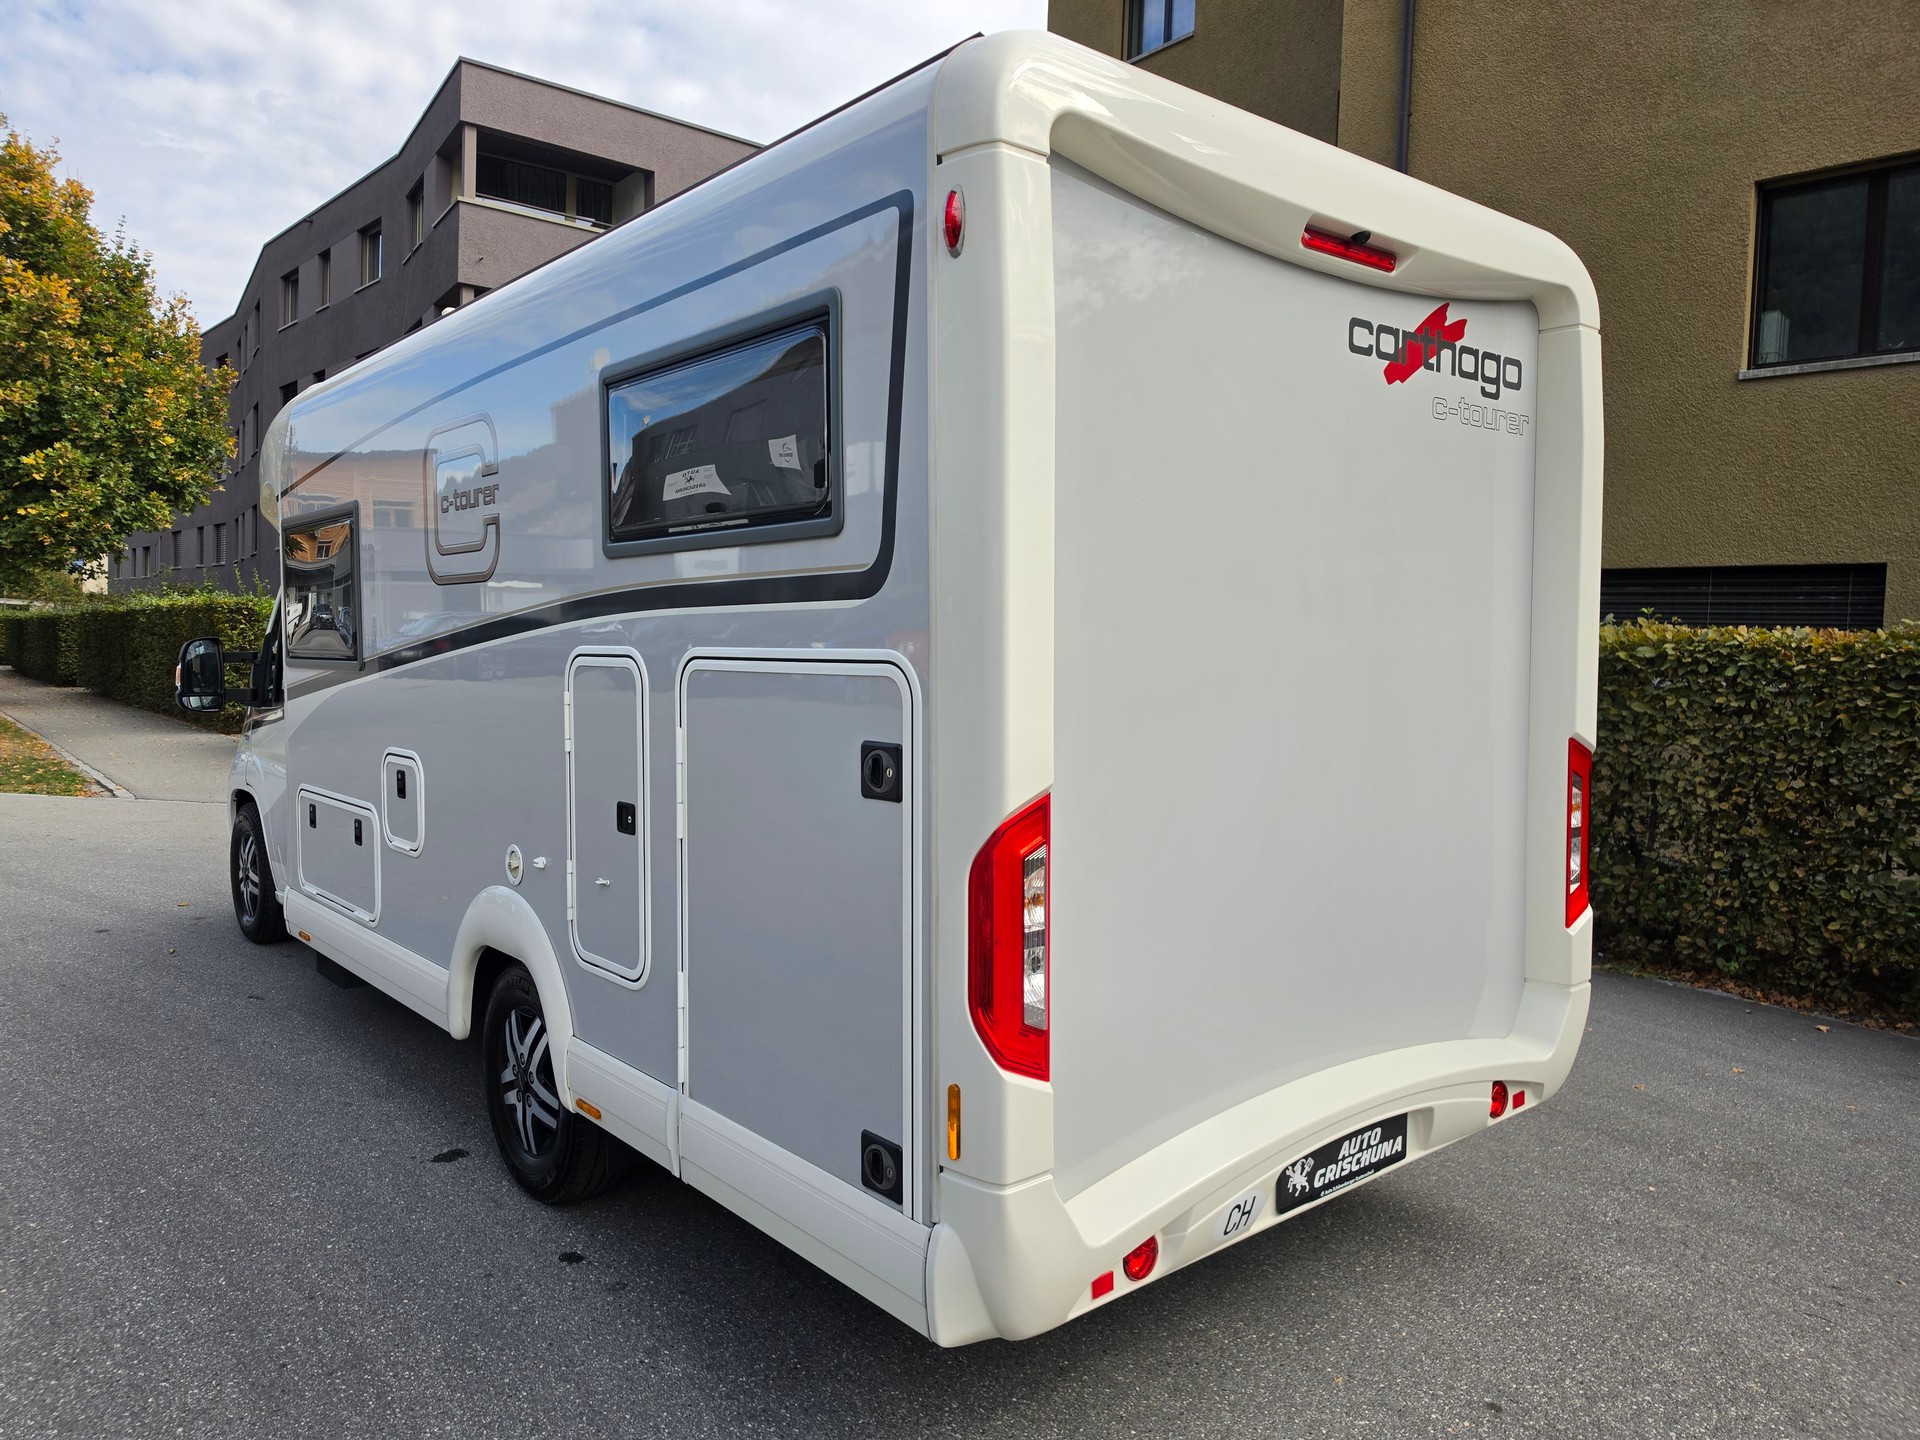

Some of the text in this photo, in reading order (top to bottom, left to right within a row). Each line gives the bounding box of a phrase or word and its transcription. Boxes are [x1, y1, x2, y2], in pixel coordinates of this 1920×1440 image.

[1349, 317, 1522, 400] carthago
[1432, 397, 1529, 436] c-tourer
[440, 484, 499, 514] c-tourer
[1314, 1135, 1403, 1188] GRISCHUNA
[1338, 1127, 1382, 1160] AUTO
[1223, 1196, 1256, 1236] CH
